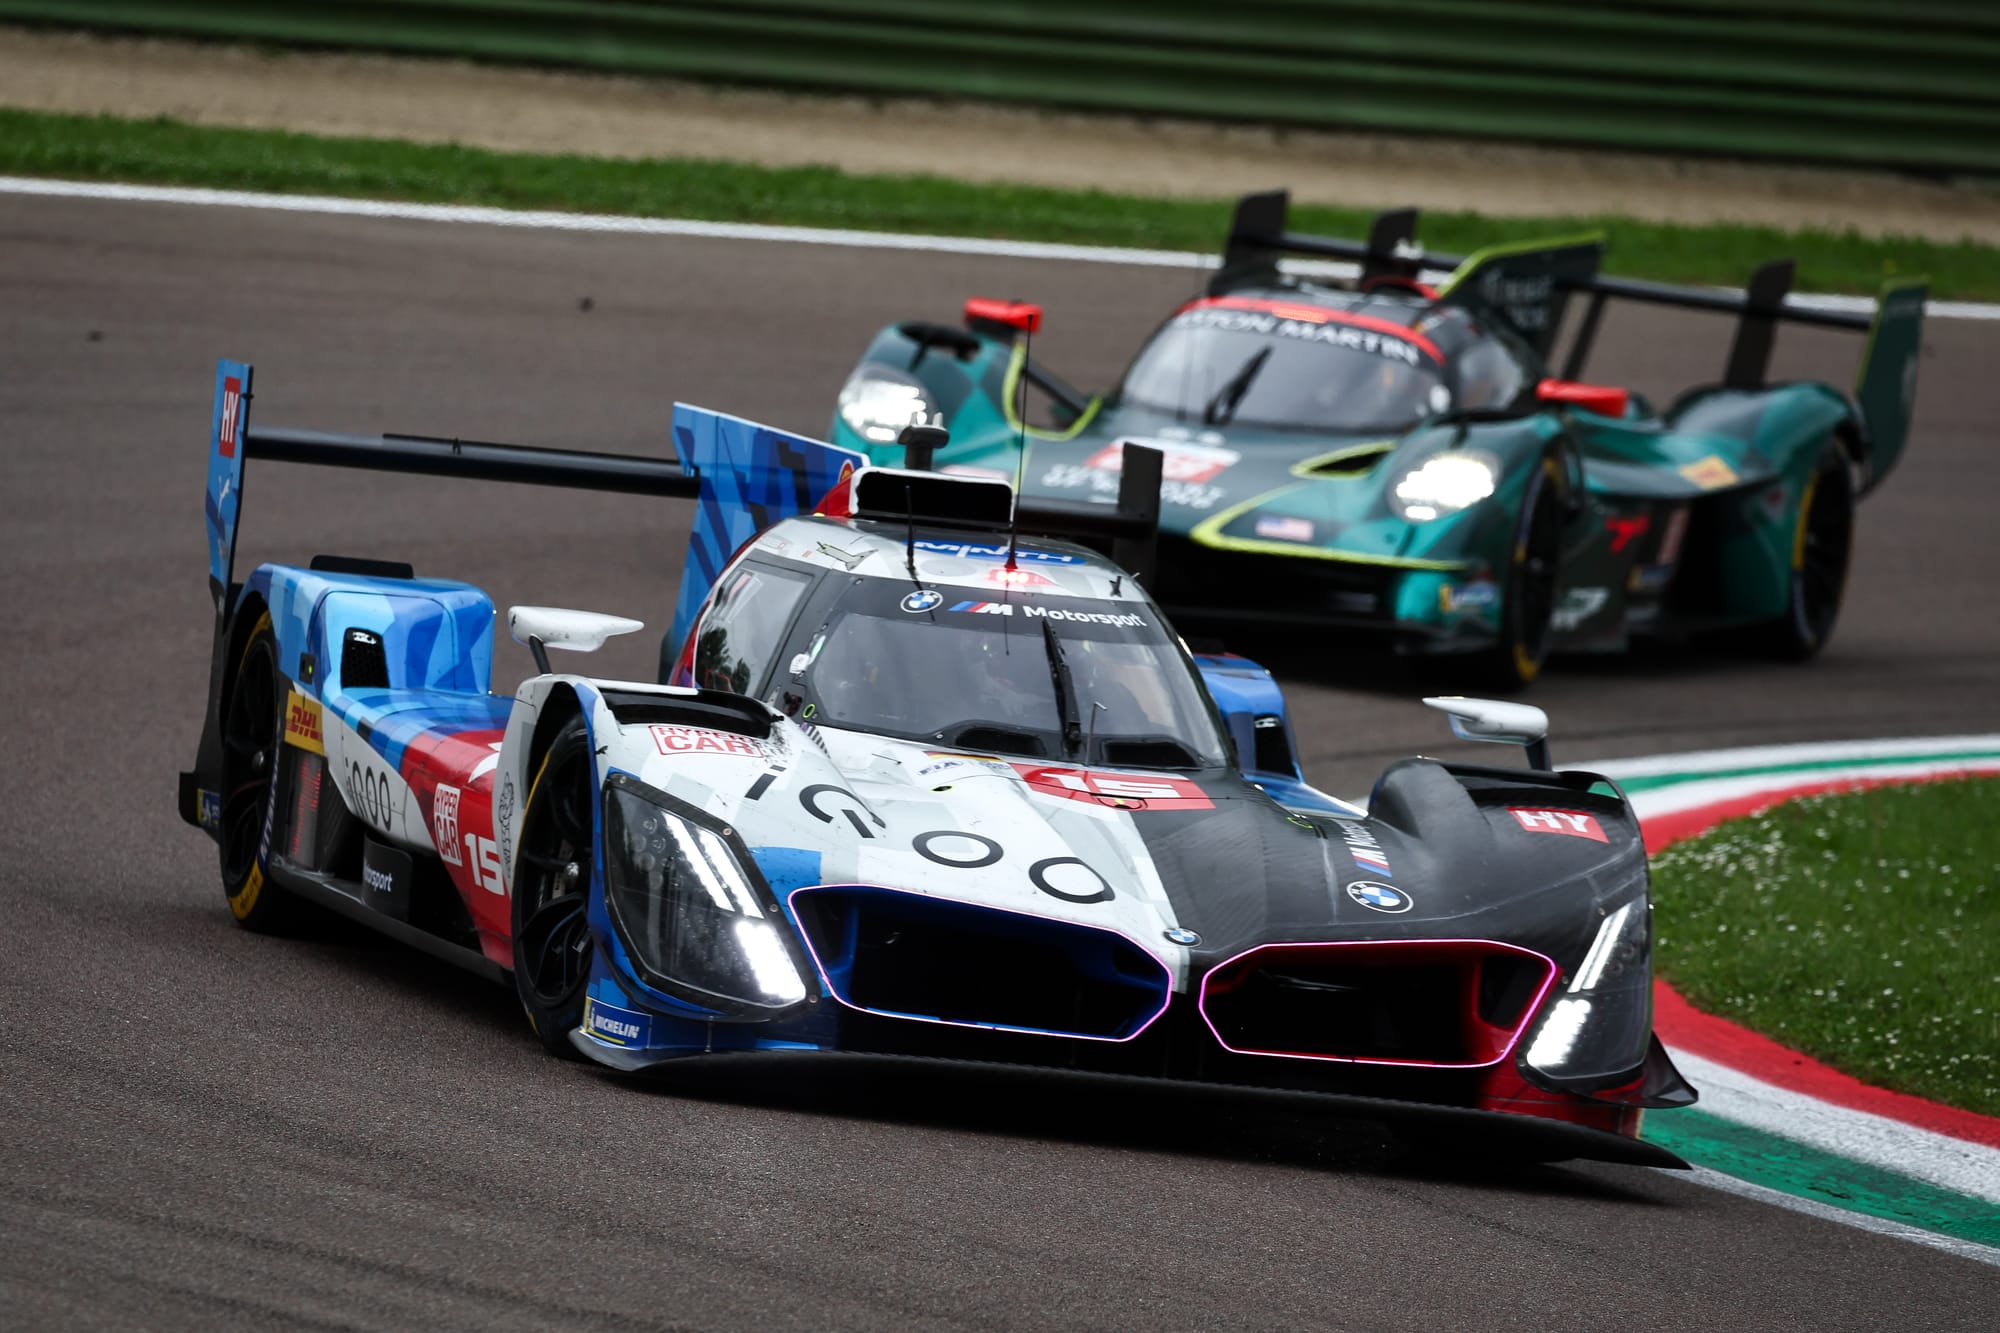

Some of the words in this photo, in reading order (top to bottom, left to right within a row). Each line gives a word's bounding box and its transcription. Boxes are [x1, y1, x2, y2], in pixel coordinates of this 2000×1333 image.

[1278, 319, 1419, 368] MARTIN
[220, 390, 239, 443] HY
[1022, 605, 1148, 629] Motorsport
[290, 703, 322, 740] DHL
[657, 726, 748, 744] HYPER
[664, 735, 755, 755] CAR
[1039, 772, 1183, 799] 15
[436, 787, 459, 818] HYPER
[1513, 809, 1592, 833] HY
[436, 814, 462, 861] CAR
[464, 832, 505, 896] 15
[595, 1014, 640, 1039] MICHELIN
